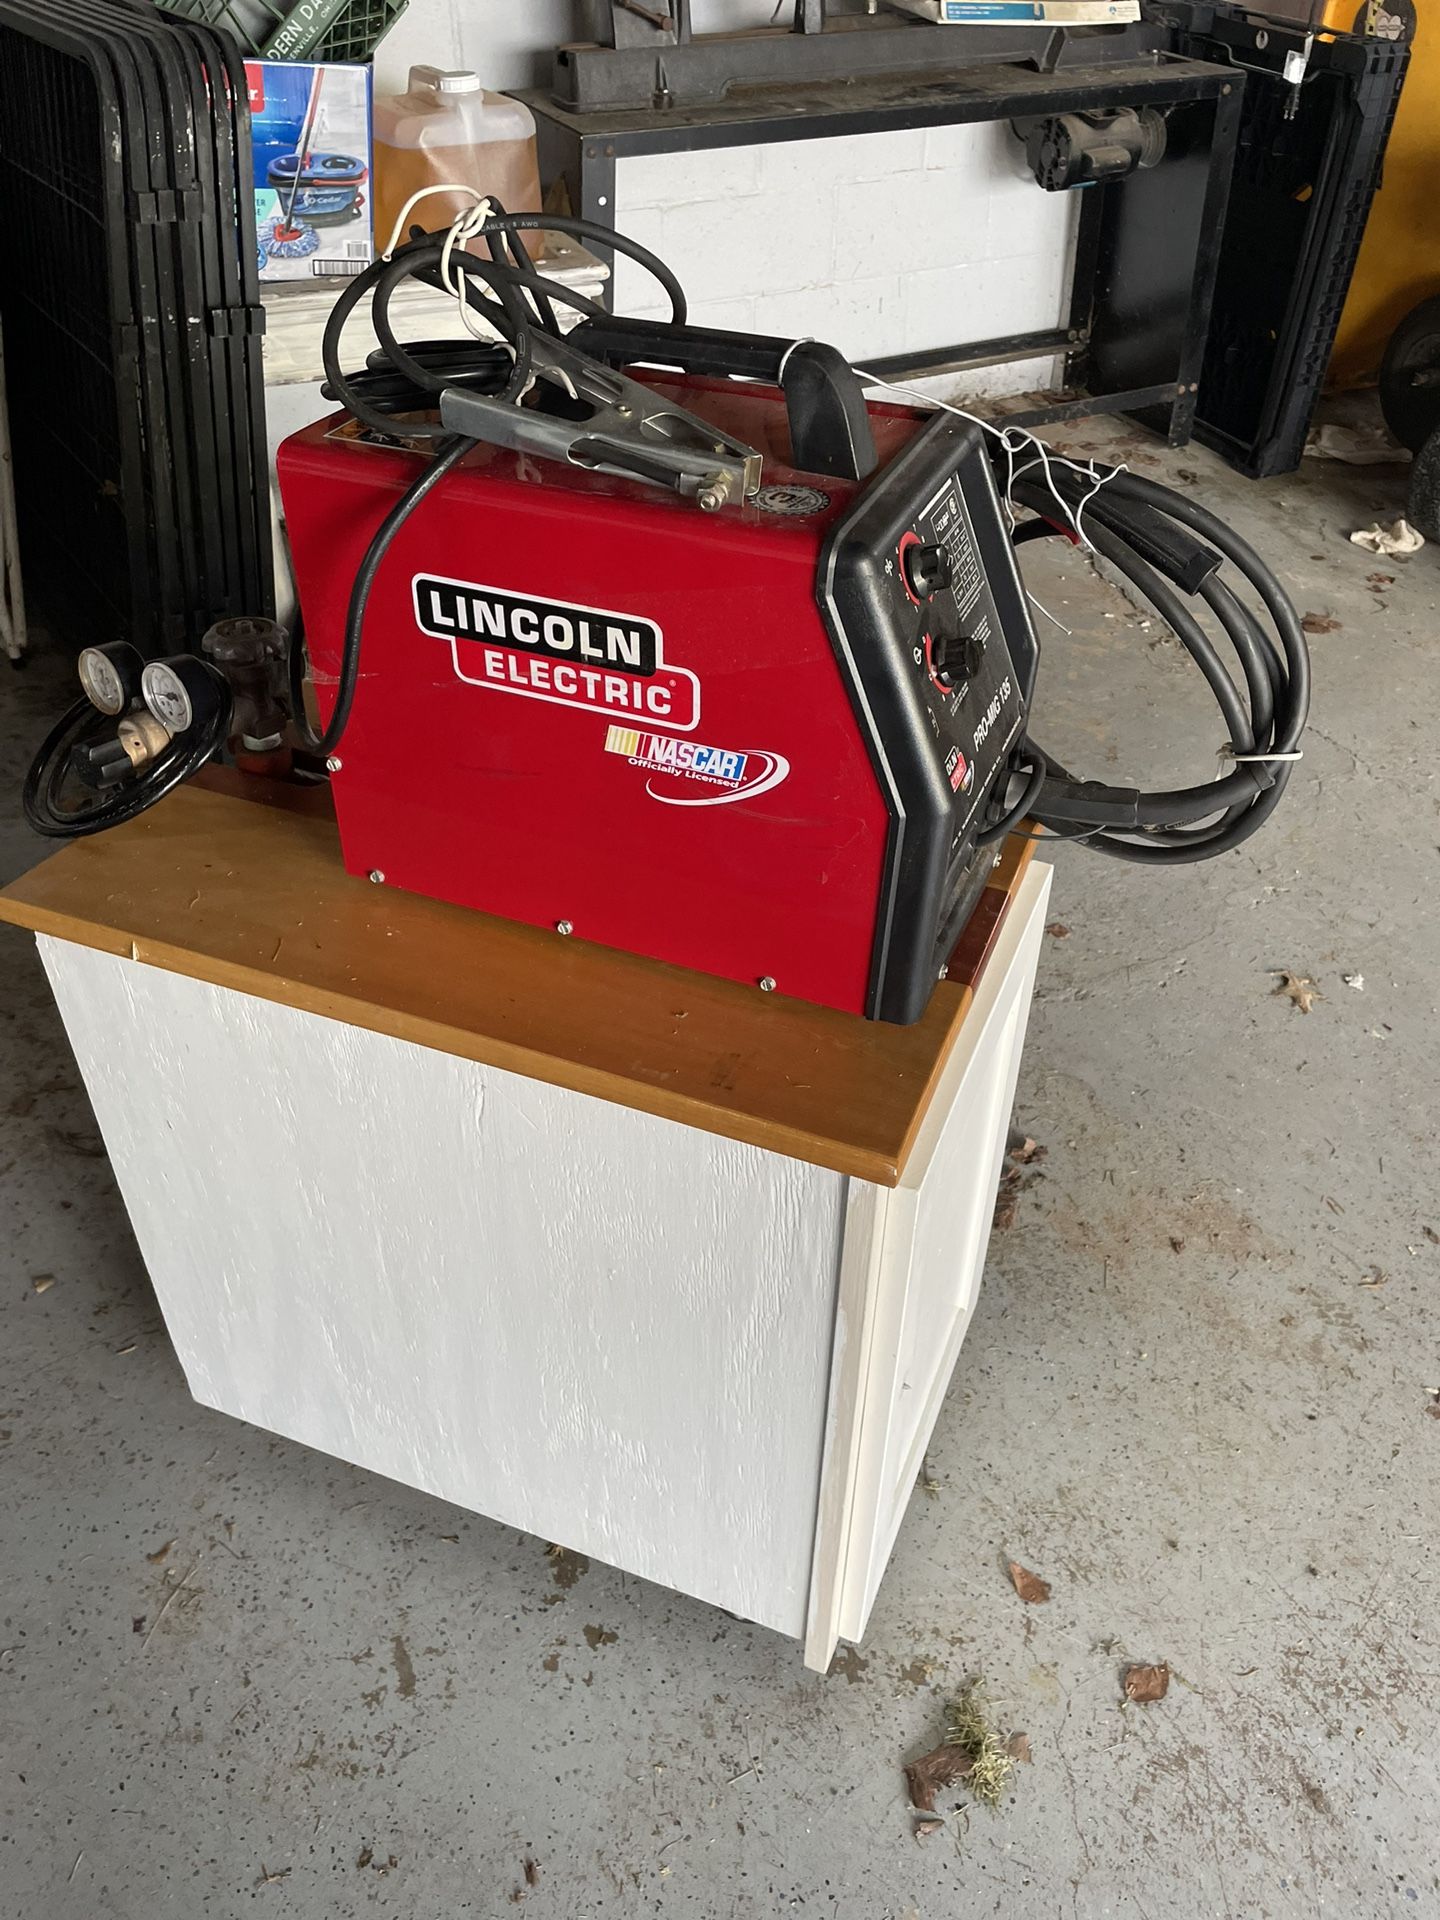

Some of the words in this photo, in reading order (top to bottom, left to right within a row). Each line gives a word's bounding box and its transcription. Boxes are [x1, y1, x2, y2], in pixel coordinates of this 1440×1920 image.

[430, 590, 640, 667] LINCOLN
[484, 649, 673, 716] ELECTRIC
[973, 695, 1001, 752] PRO-MIG
[999, 676, 1011, 704] 135
[627, 757, 682, 777] Officially
[684, 770, 740, 789] Licensed
[646, 736, 739, 780] NASCAR
